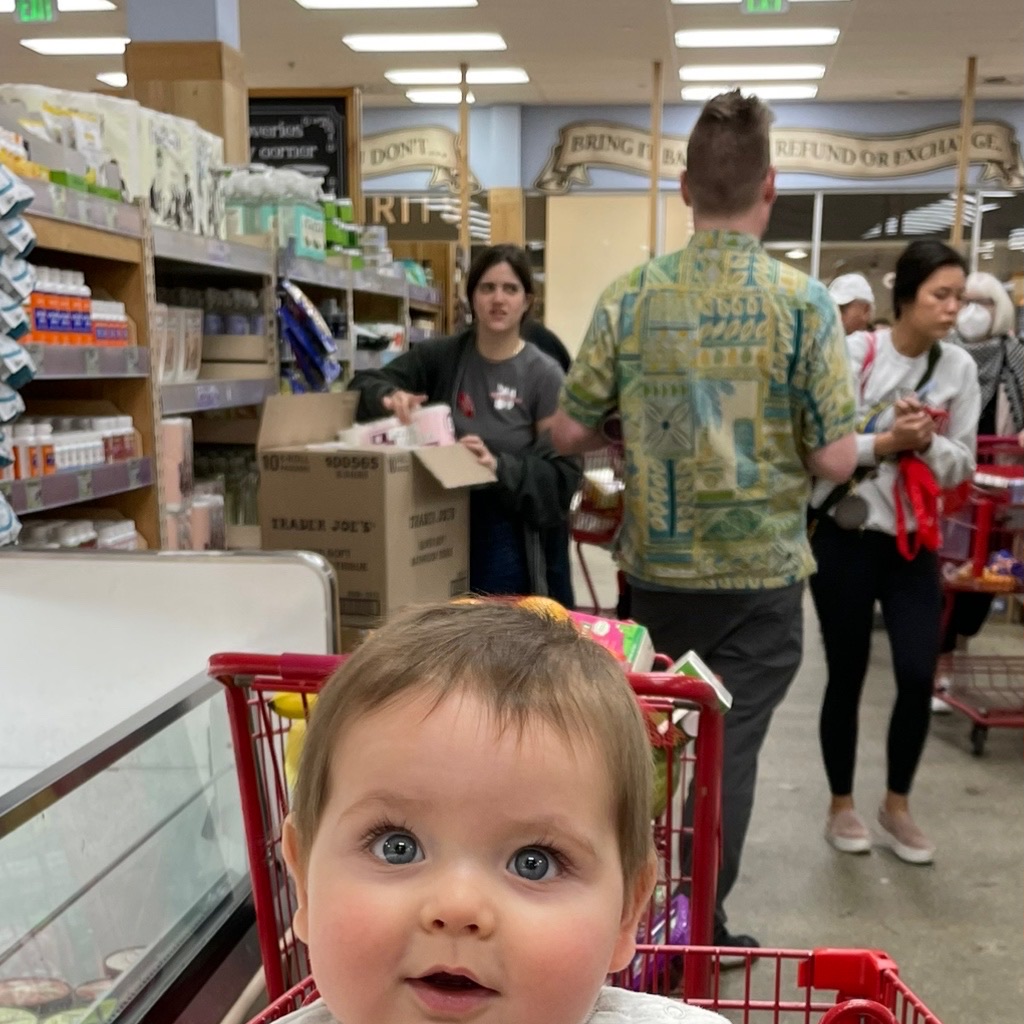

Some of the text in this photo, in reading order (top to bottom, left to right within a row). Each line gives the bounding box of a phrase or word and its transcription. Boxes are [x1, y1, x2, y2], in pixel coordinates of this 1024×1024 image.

[570, 133, 633, 153] BRING
[775, 140, 857, 166] REFUND
[860, 149, 890, 167] OR
[271, 517, 372, 533] TRADER JOE'S
